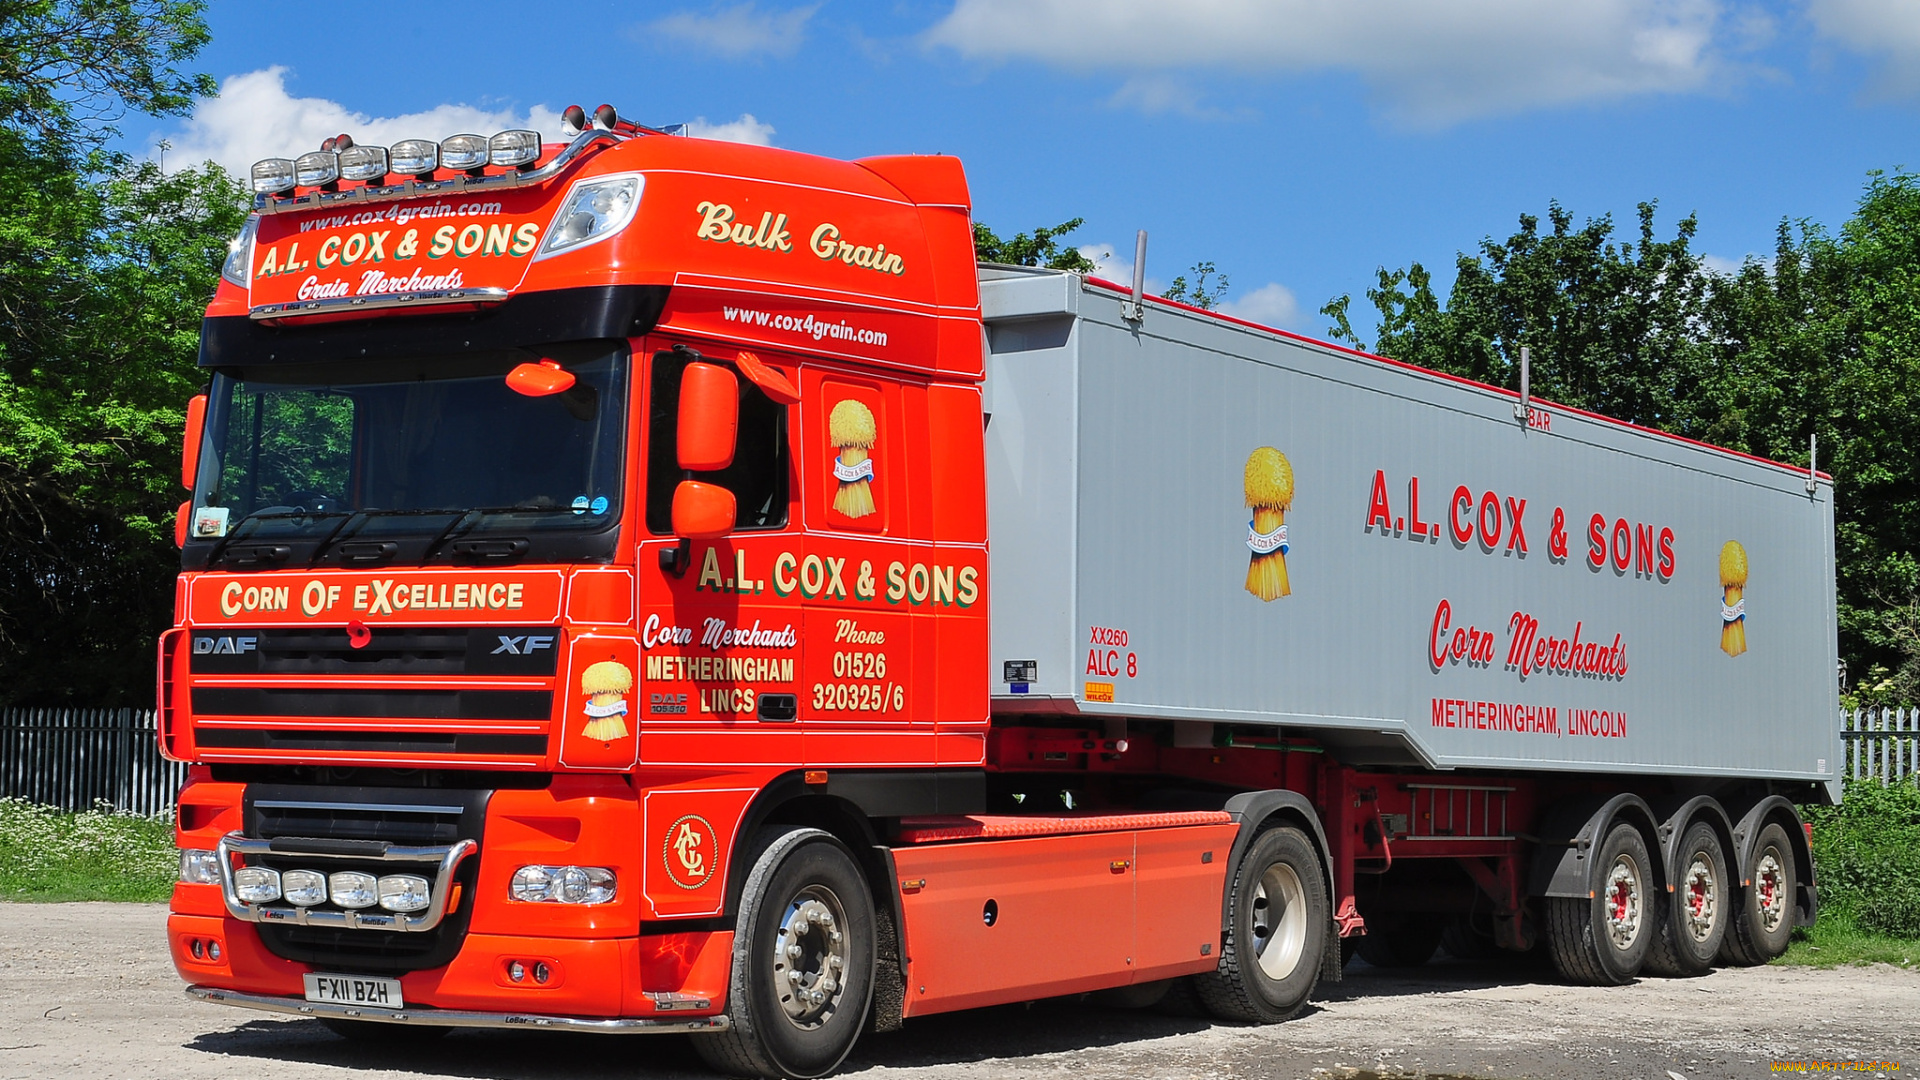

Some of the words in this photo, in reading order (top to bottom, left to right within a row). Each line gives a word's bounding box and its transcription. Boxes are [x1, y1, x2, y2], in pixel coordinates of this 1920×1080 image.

[300, 201, 502, 232] www.cox4grain.com
[256, 245, 309, 278] A.L.
[316, 230, 390, 268] COX
[393, 228, 420, 260] &
[430, 221, 541, 259] SONS
[696, 201, 793, 253] Bulk
[809, 223, 906, 276] Grain
[297, 274, 349, 300] Grain
[359, 267, 464, 297] Merchants
[723, 306, 888, 347] www.cox4grain.com
[1528, 408, 1551, 432] BAR
[1364, 469, 1441, 545] A.L.
[1448, 484, 1529, 560] COX
[1548, 506, 1569, 565] &
[1586, 512, 1676, 585] SONS
[697, 547, 766, 595] A.L.
[773, 552, 847, 600] COX
[855, 560, 876, 600] &
[885, 561, 980, 608] SONS
[193, 636, 257, 655] DAF
[490, 635, 555, 656] XF
[641, 613, 693, 650] Corn
[700, 617, 797, 650] Merchants
[834, 619, 886, 645] Phone
[1090, 626, 1128, 647] XX260
[1428, 598, 1496, 675] Corn
[1503, 610, 1629, 684] Merchants
[646, 656, 794, 683] METHERINGHAM
[833, 651, 886, 679] 01526
[1086, 649, 1119, 677] ALC
[1126, 652, 1138, 678] 8
[650, 693, 688, 704] DAF
[701, 688, 755, 713] LINCS
[812, 682, 904, 714] 320325/6
[1086, 693, 1112, 702] WILCOX
[1431, 697, 1562, 739] METHERINGHAM,
[1568, 708, 1627, 738] LINCOLN
[317, 977, 351, 1001] FX11
[354, 980, 389, 1004] BZH
